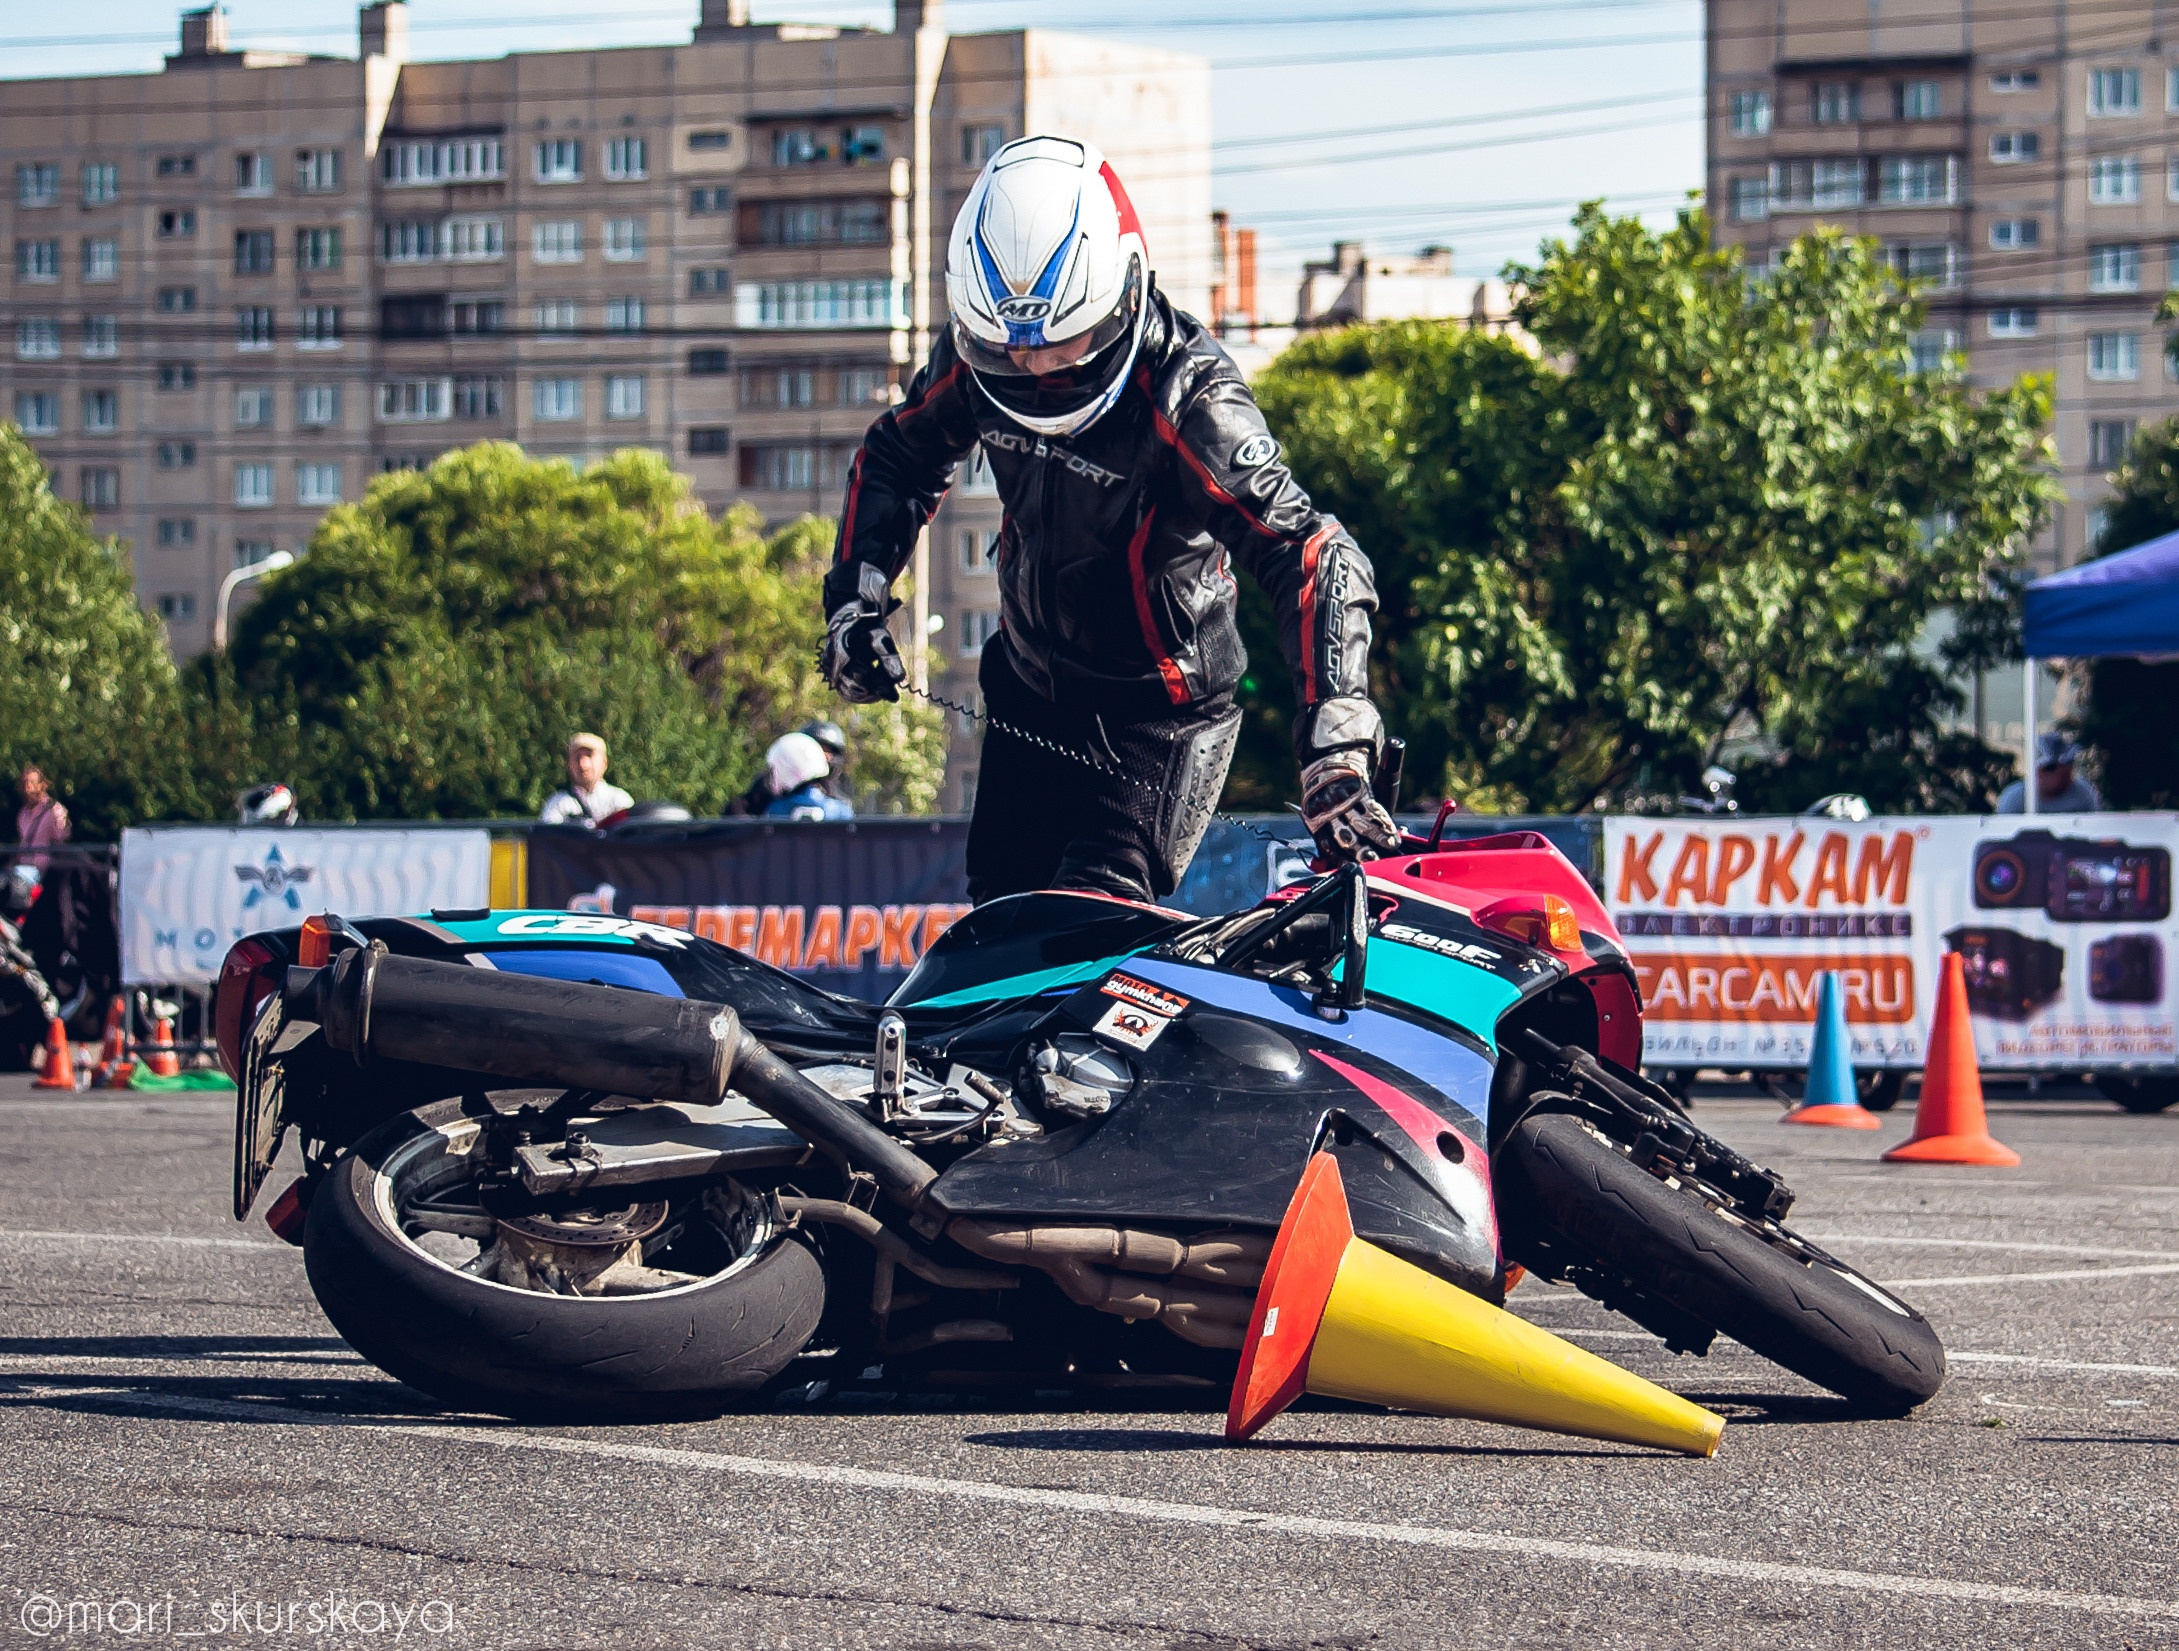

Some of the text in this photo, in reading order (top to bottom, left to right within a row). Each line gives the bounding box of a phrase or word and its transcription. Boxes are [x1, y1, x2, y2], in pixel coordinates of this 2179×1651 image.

[979, 429, 1127, 487] AGVPORT
[1616, 829, 1916, 908] КАРКАМ
[153, 927, 245, 952] МО
[497, 914, 695, 950] CBR
[1633, 966, 1906, 1010] CARCAMRU
